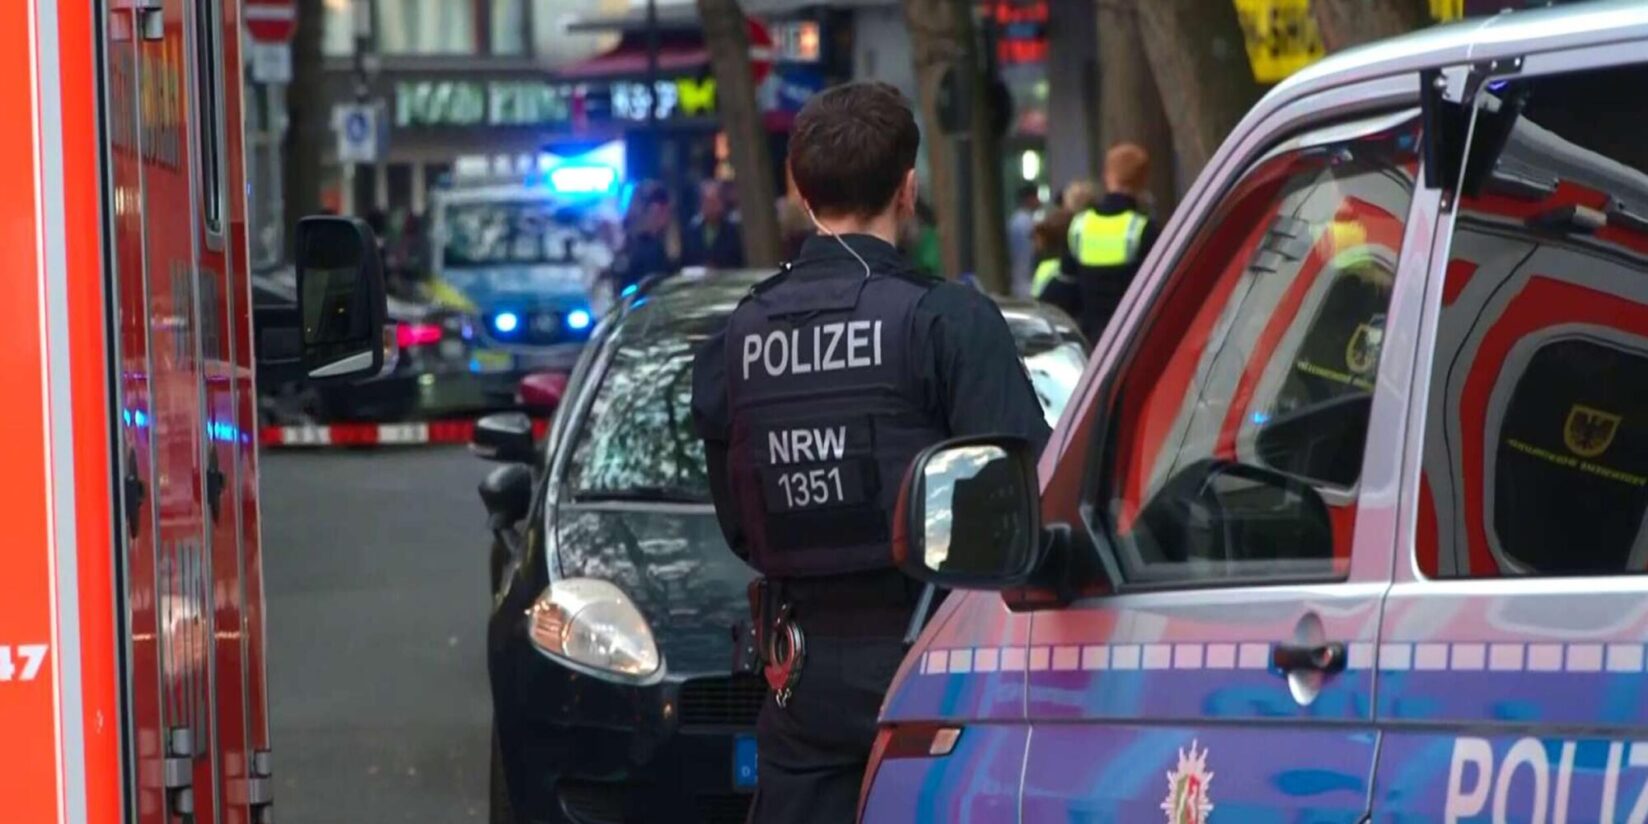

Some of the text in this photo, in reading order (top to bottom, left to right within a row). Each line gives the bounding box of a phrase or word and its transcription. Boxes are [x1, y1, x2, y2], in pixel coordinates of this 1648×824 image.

[743, 320, 882, 380] POLIZEI
[768, 426, 846, 464] NRW
[778, 467, 844, 508] 1351
